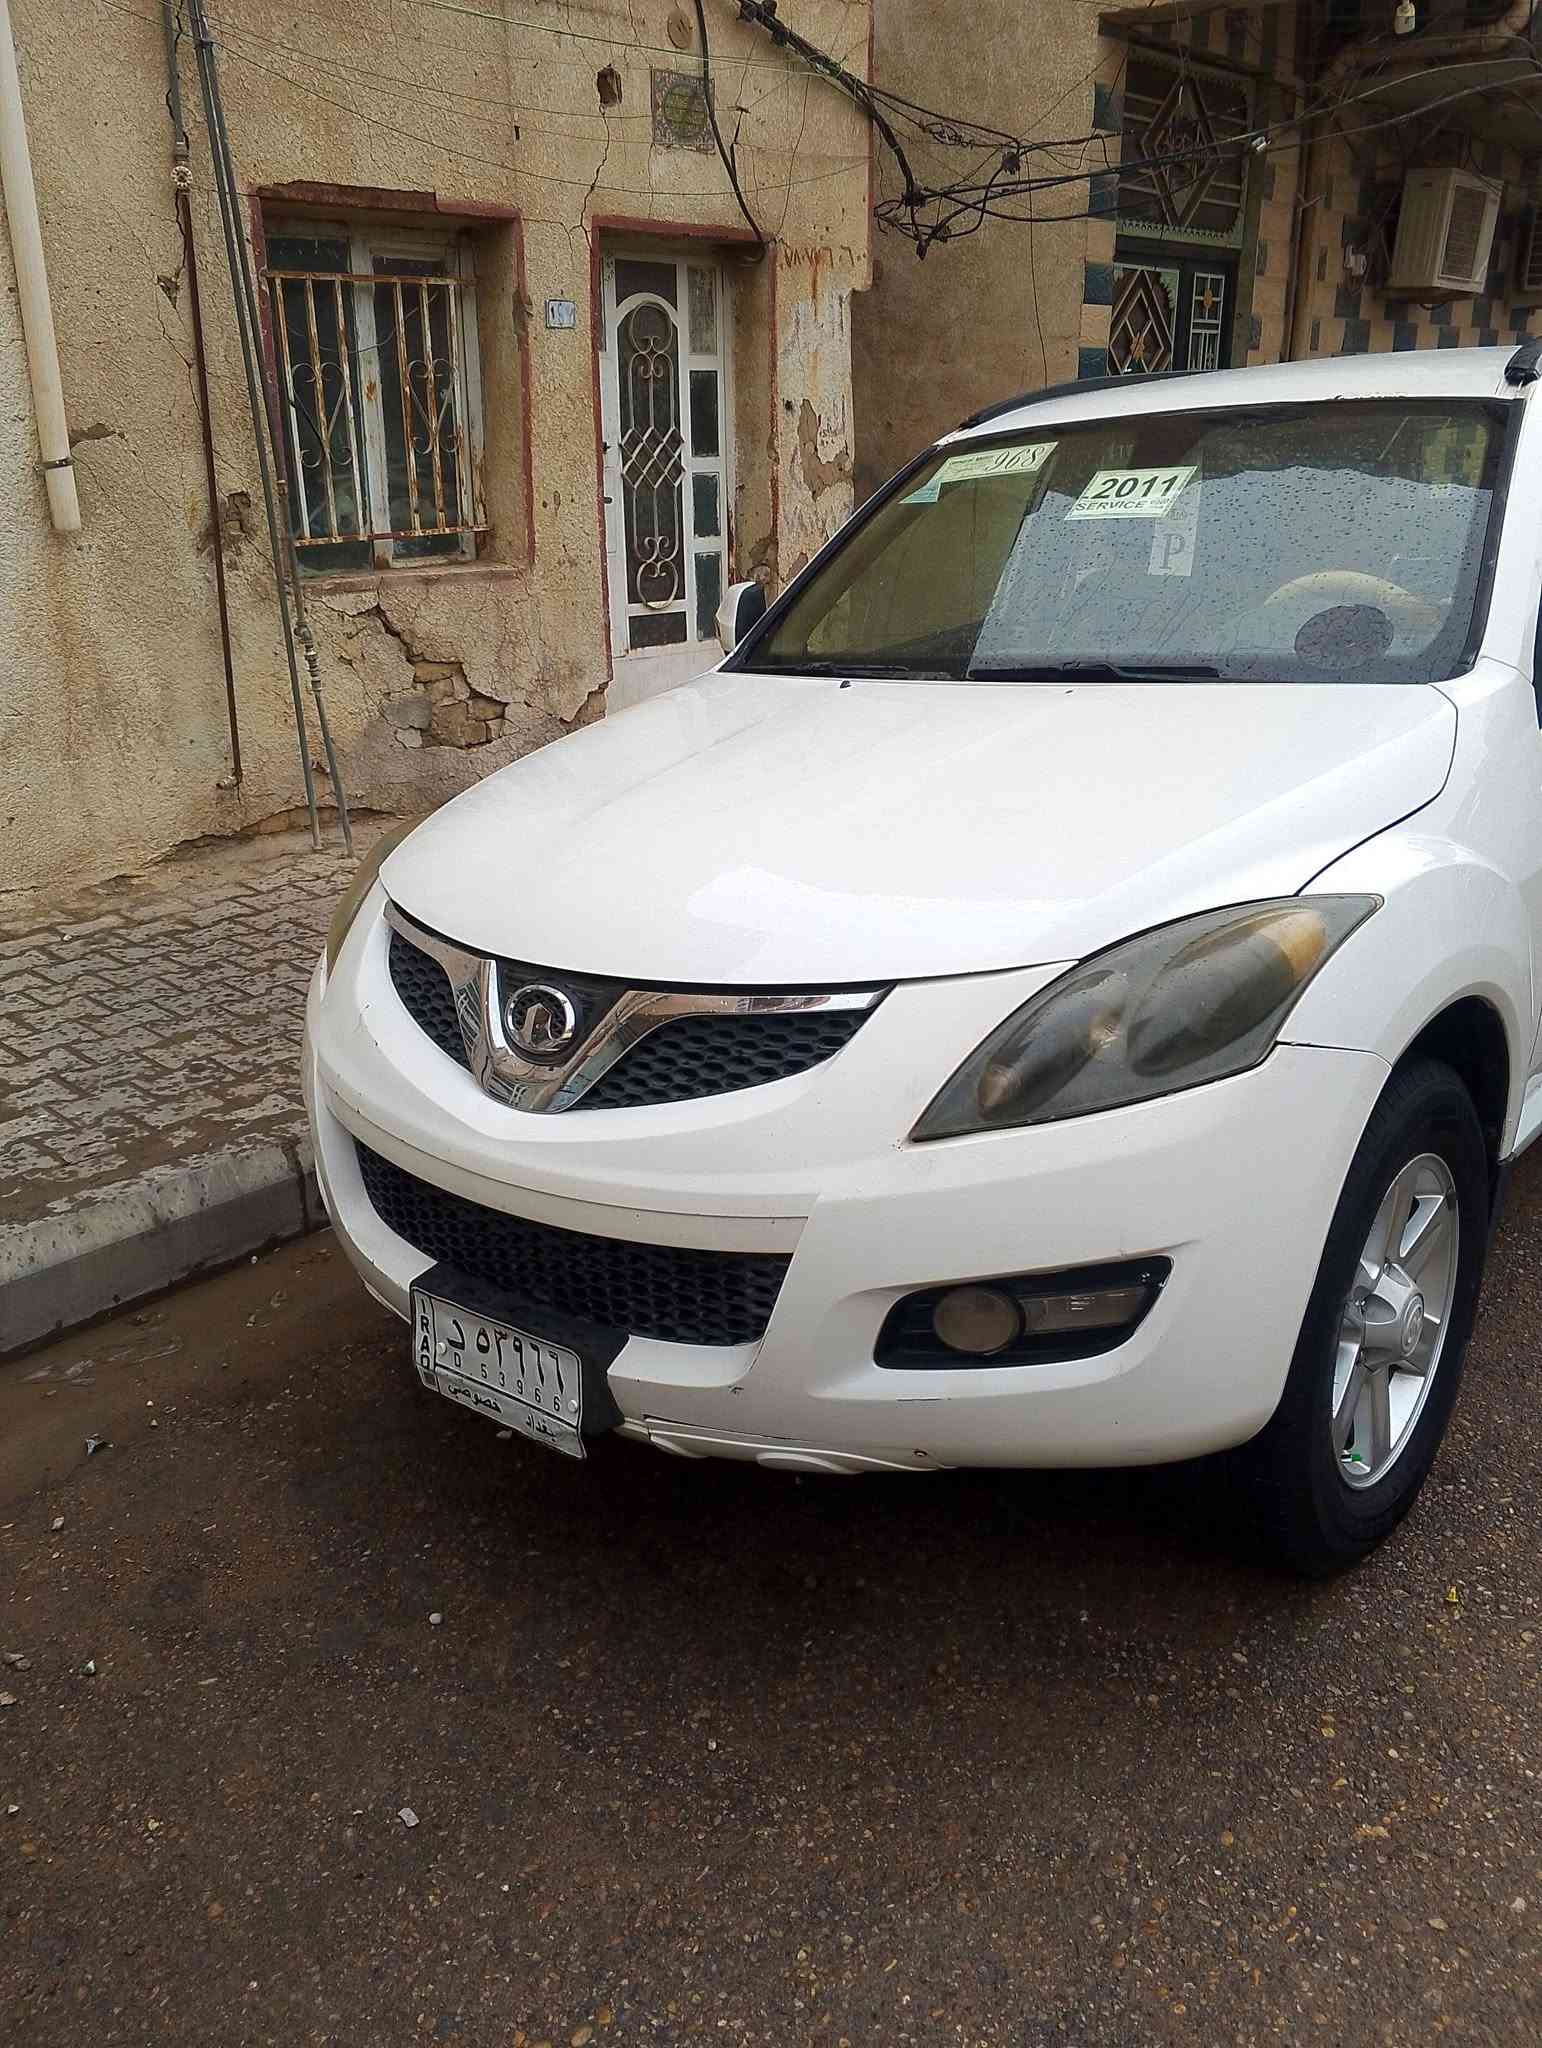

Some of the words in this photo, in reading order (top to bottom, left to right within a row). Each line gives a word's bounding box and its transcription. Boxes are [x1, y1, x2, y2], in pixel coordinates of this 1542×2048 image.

[985, 447, 1044, 472] 968
[1091, 475, 1179, 500] 2011
[1075, 500, 1145, 512] SERVICE
[1160, 532, 1185, 571] P
[448, 1384, 502, 1413] خصوصي
[481, 1363, 561, 1412] 53966
[526, 1413, 557, 1442] بغداد
